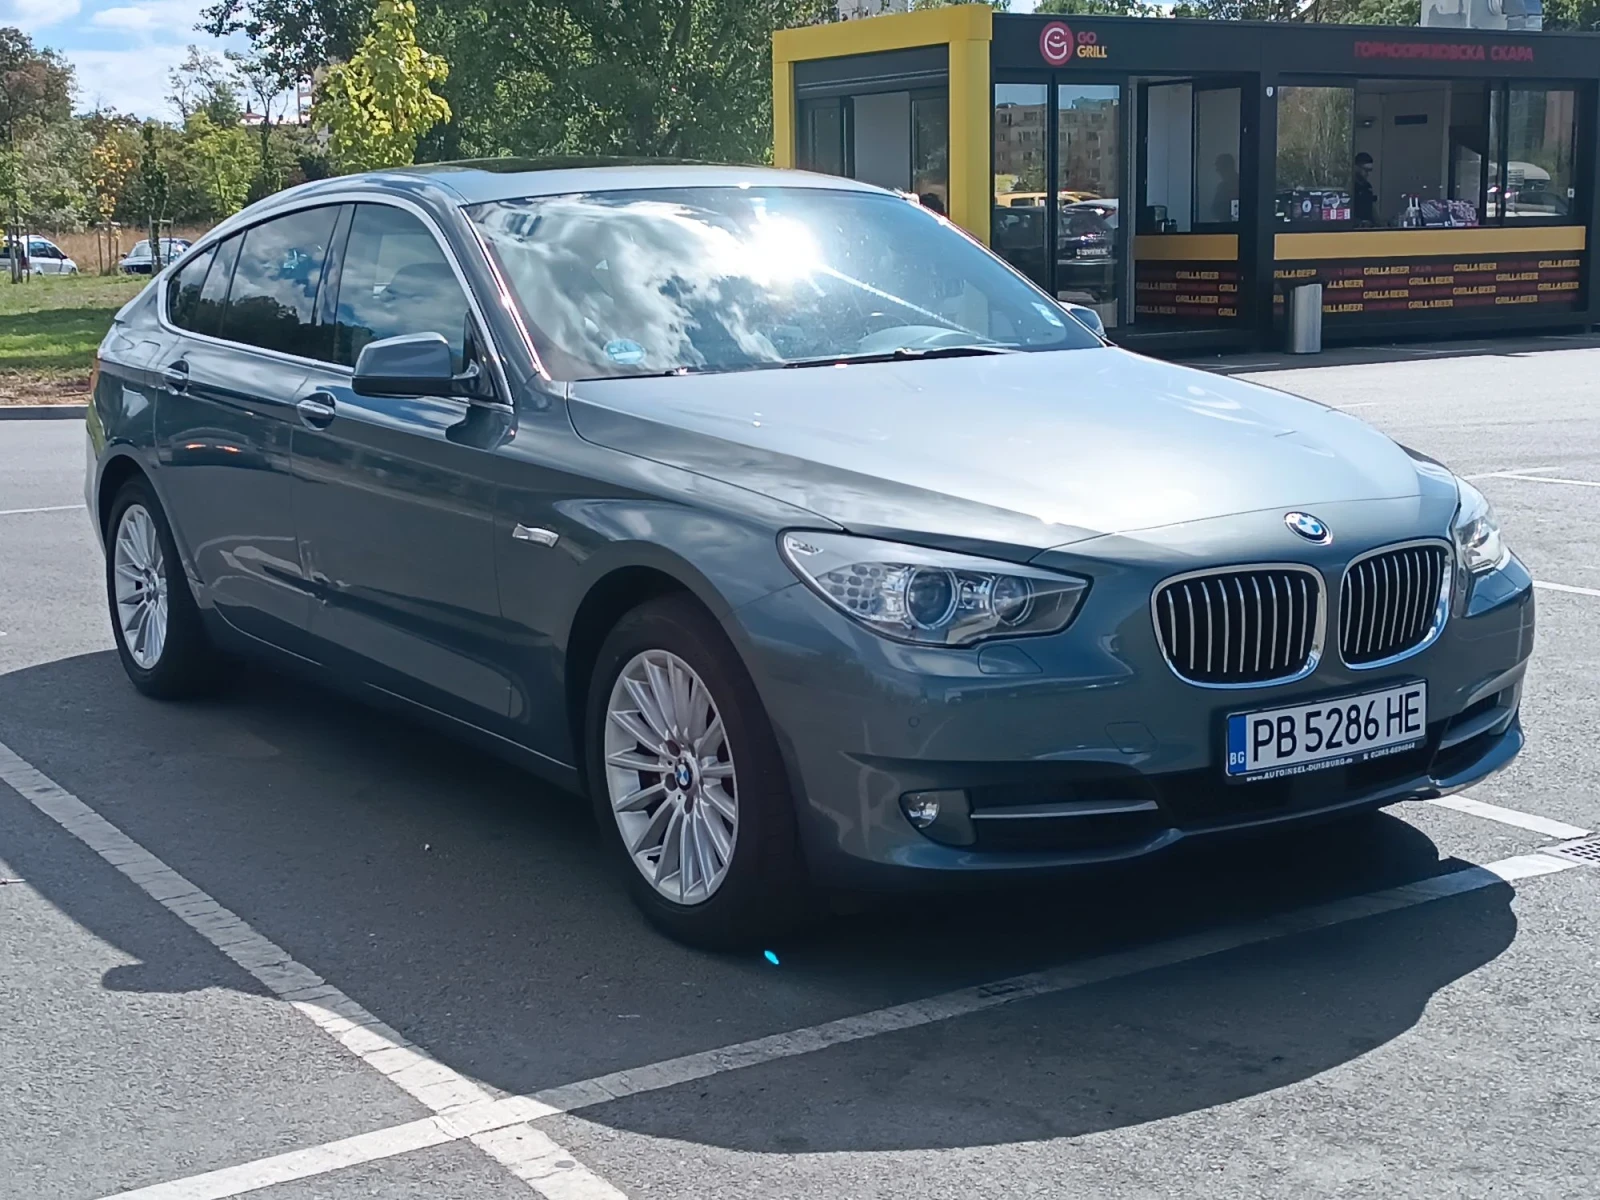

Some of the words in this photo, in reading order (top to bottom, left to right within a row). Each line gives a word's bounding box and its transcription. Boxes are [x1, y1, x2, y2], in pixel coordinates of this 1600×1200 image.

[1077, 31, 1097, 44] GO
[1077, 45, 1107, 58] GRILL
[1490, 45, 1533, 62] СКАРА
[1229, 751, 1245, 766] BG
